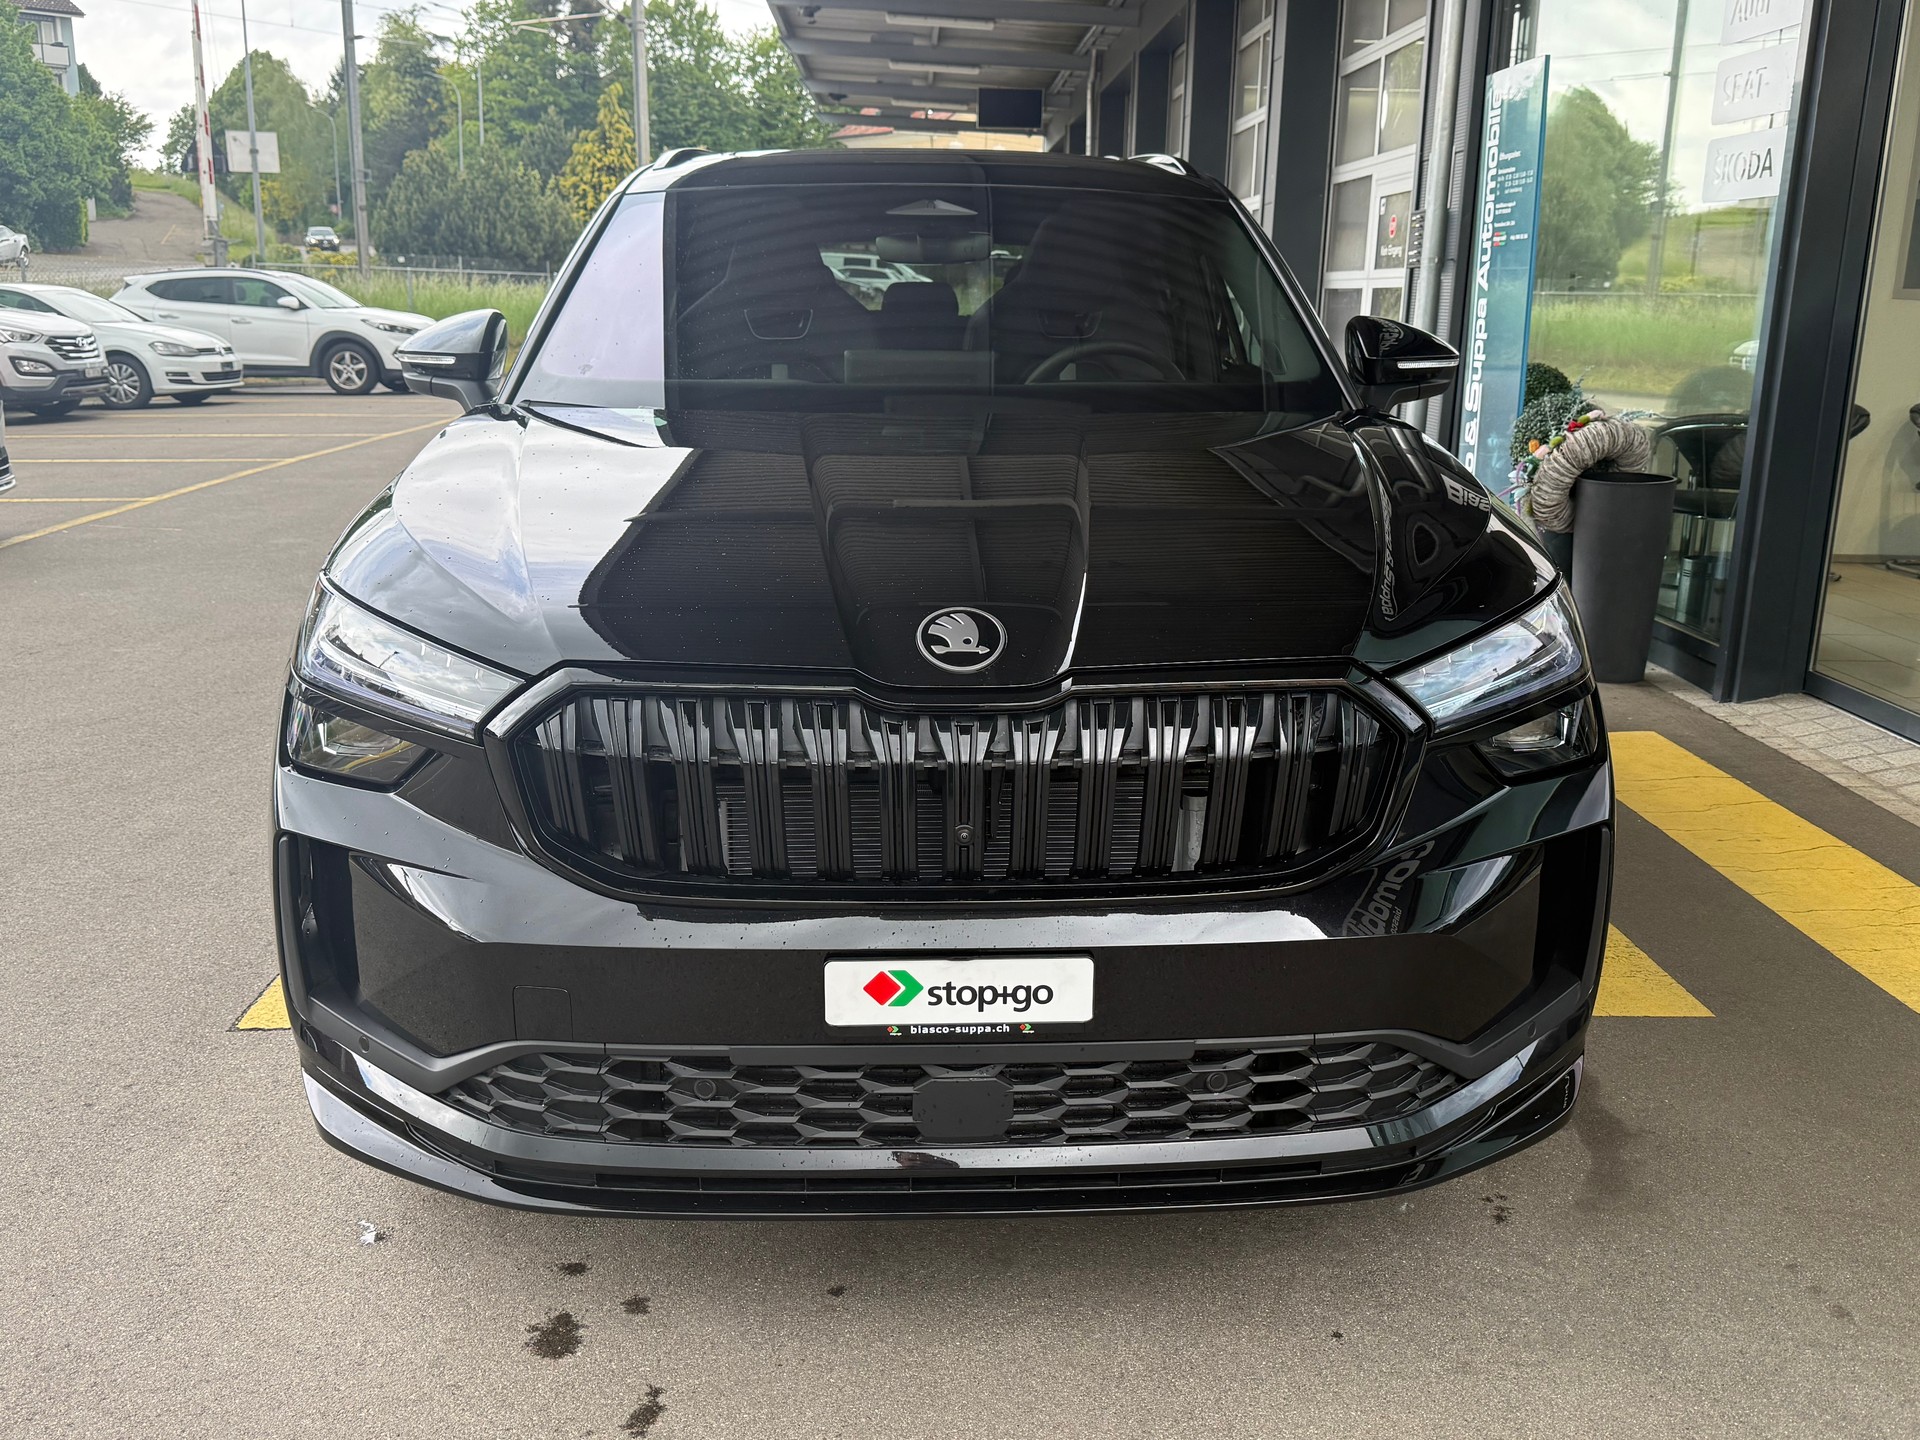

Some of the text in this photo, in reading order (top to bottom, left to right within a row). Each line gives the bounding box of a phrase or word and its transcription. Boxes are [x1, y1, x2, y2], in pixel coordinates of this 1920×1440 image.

[1723, 66, 1768, 104] SEAT
[1477, 91, 1502, 291] Automobile
[1465, 298, 1488, 412] Suppa
[1465, 417, 1478, 445] &
[927, 981, 1054, 1012] stop+go
[910, 1024, 1010, 1034] biasco-suppa.ch
